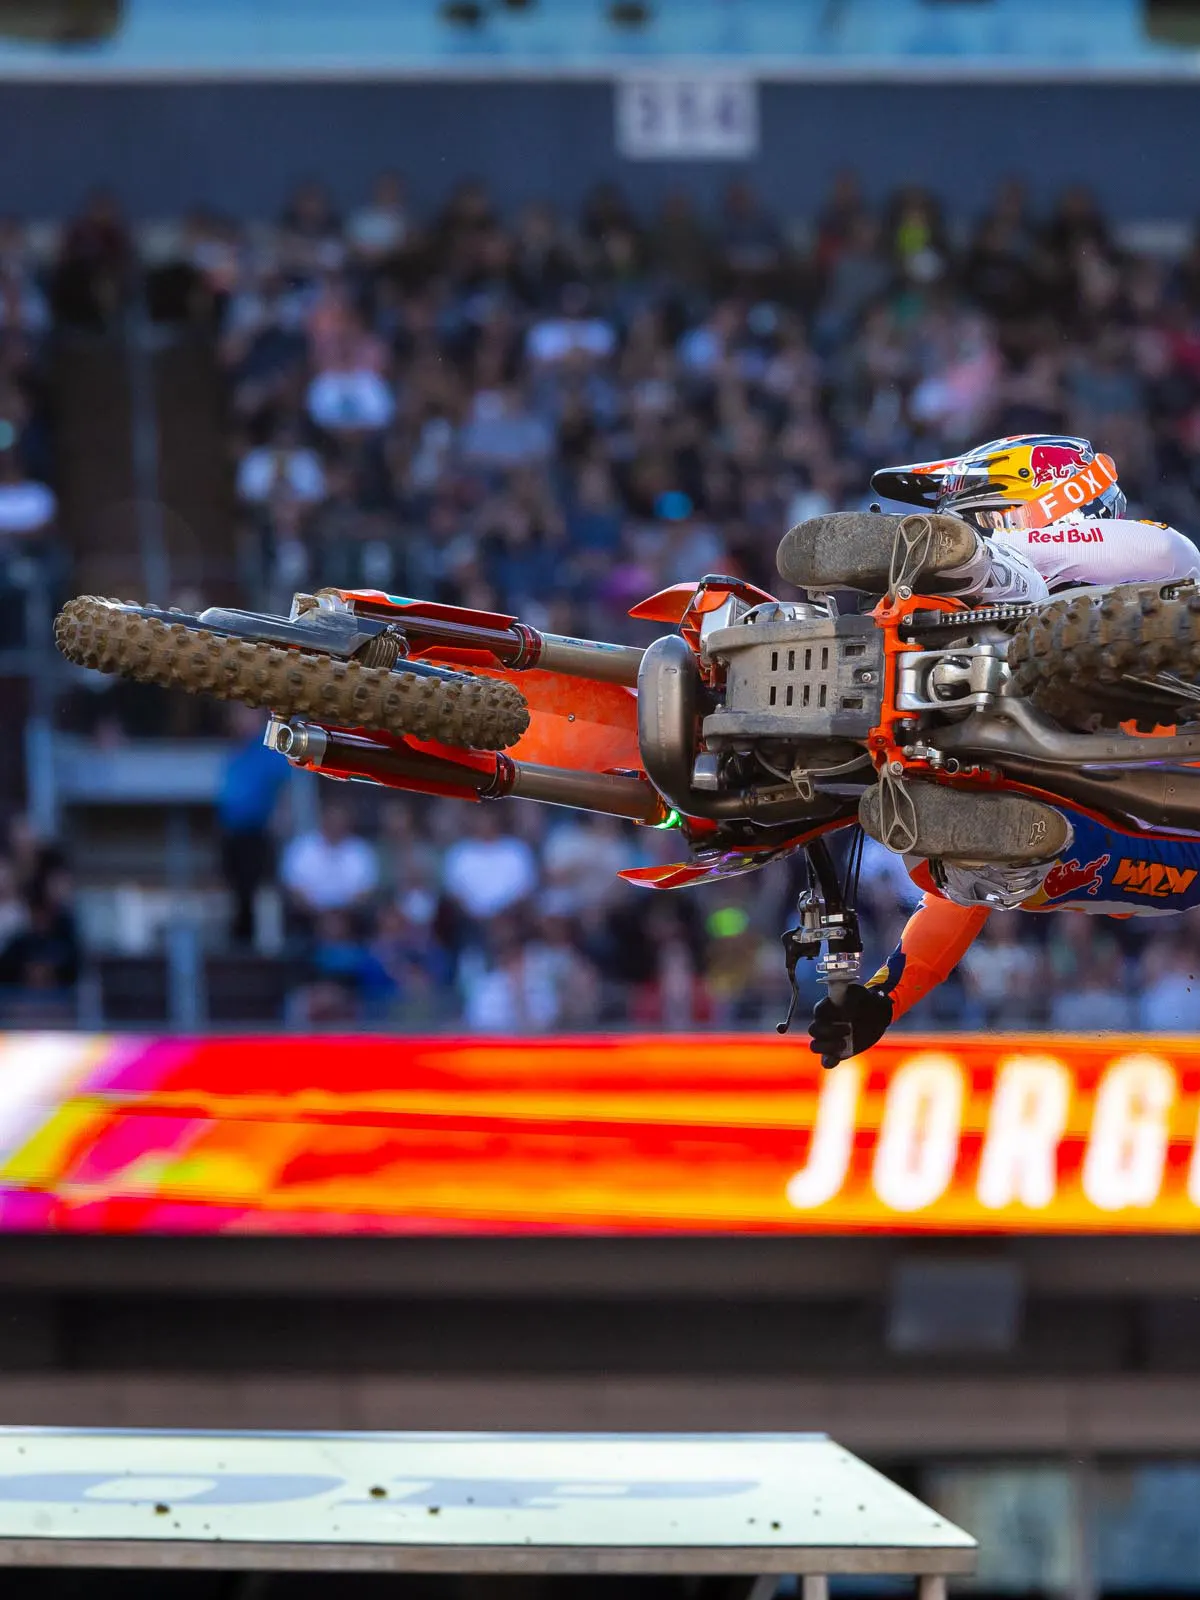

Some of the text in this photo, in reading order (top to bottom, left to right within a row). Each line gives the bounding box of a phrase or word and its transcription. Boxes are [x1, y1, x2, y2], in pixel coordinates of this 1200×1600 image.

[1038, 472, 1103, 520] FOX
[1028, 527, 1104, 544] Red Bull
[1111, 858, 1199, 897] KTM
